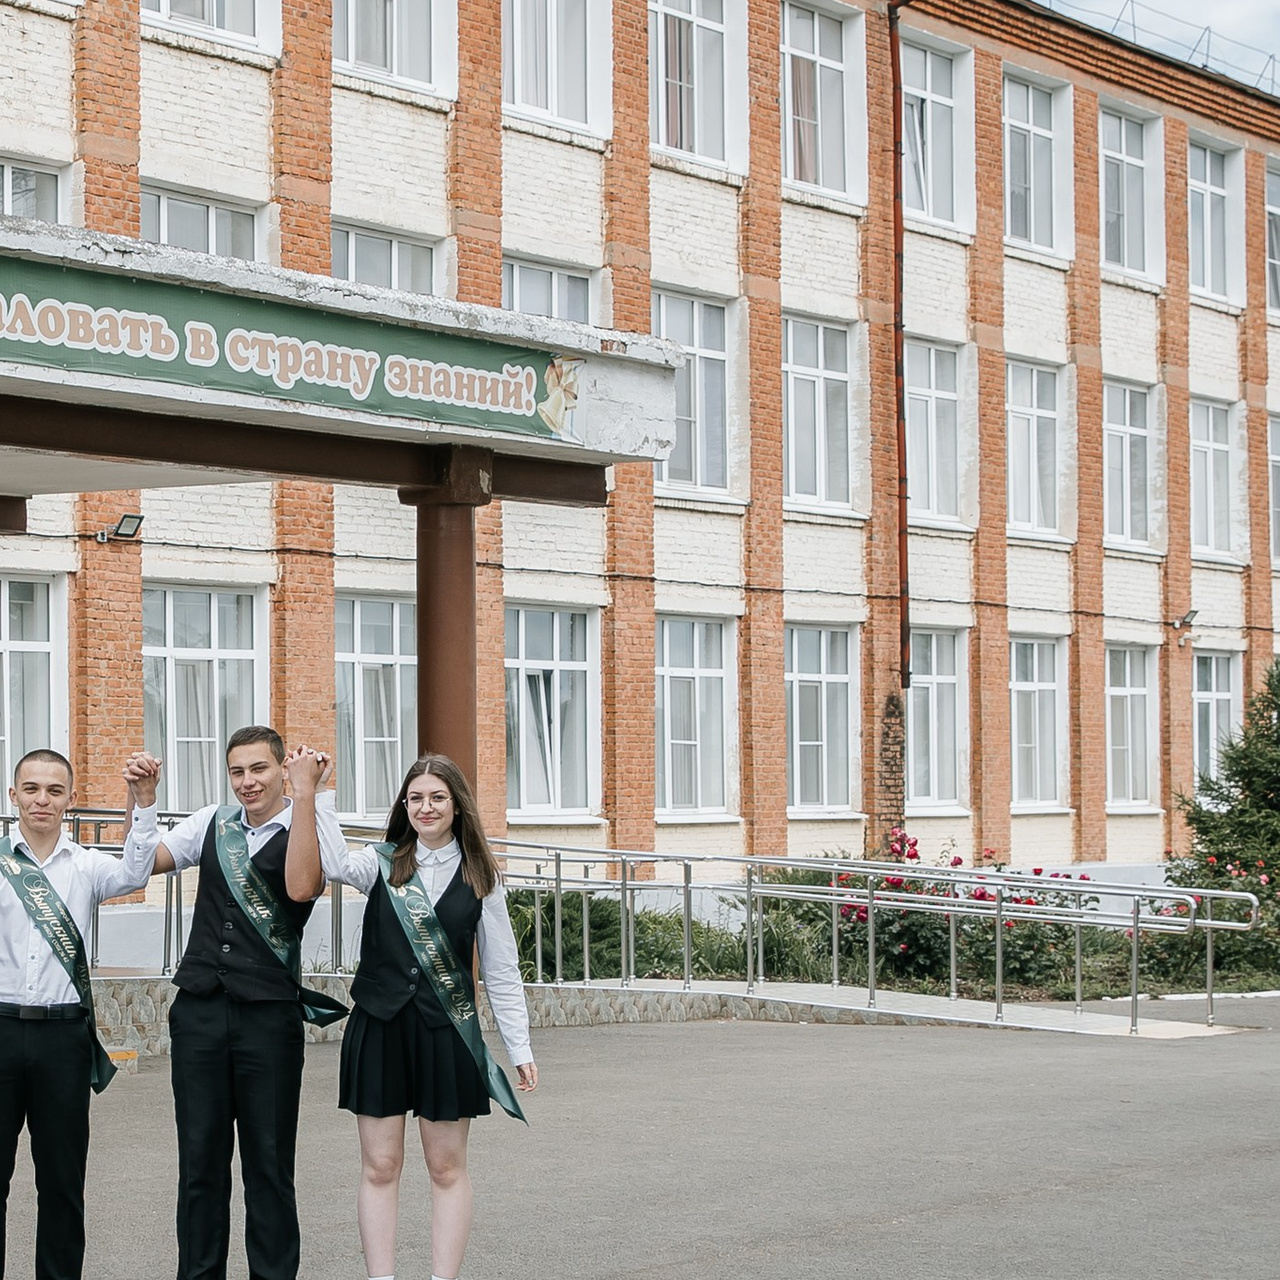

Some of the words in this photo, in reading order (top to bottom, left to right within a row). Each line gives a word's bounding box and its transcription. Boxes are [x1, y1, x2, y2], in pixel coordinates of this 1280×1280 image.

[184, 321, 218, 365] в
[225, 329, 380, 398] страну
[385, 356, 536, 416] знаний!
[22, 872, 77, 959] Выпускник
[225, 834, 273, 919] Выпускник
[404, 895, 456, 991] Выпускница
[451, 989, 475, 1021] 2024
